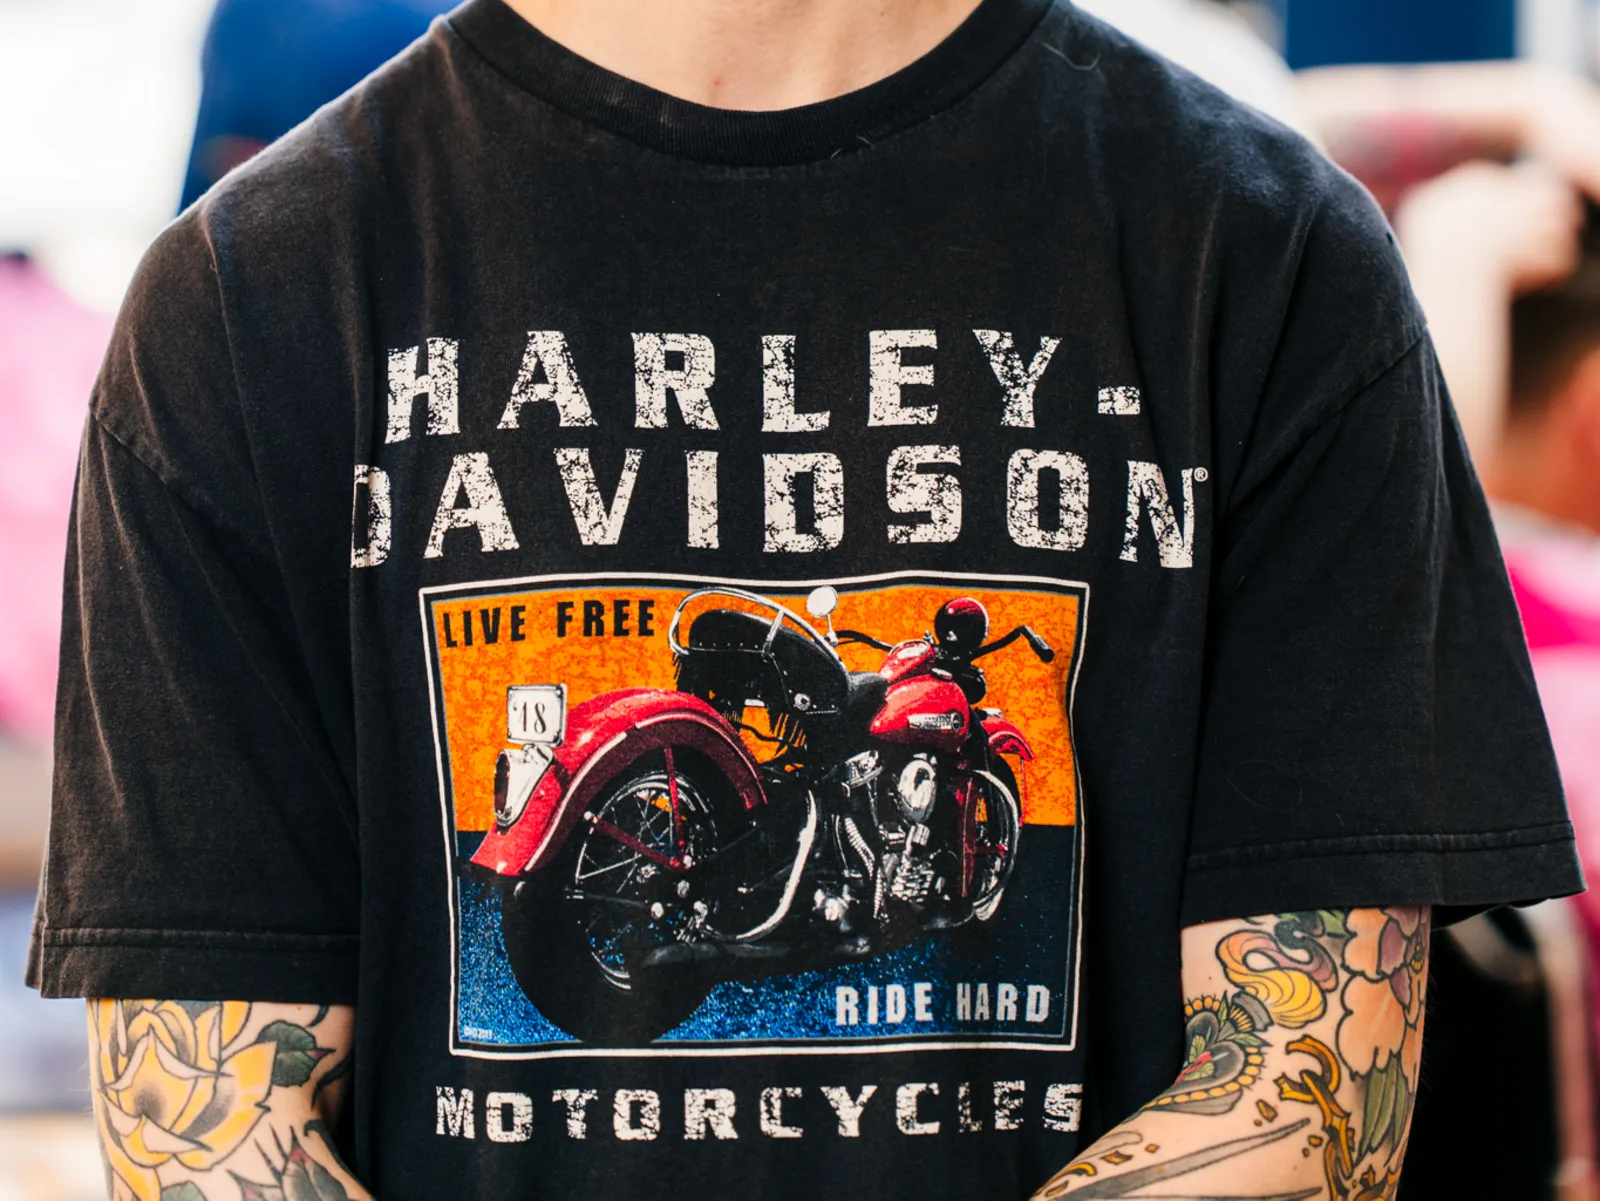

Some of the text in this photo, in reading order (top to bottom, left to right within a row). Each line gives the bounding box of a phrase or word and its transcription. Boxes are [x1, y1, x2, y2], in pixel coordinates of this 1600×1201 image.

[385, 329, 1141, 444] HARLEY-
[443, 599, 655, 648] LIVE FREE
[835, 982, 1051, 1025] RIDE HARD
[435, 1080, 1084, 1143] MOTORCYCLES
